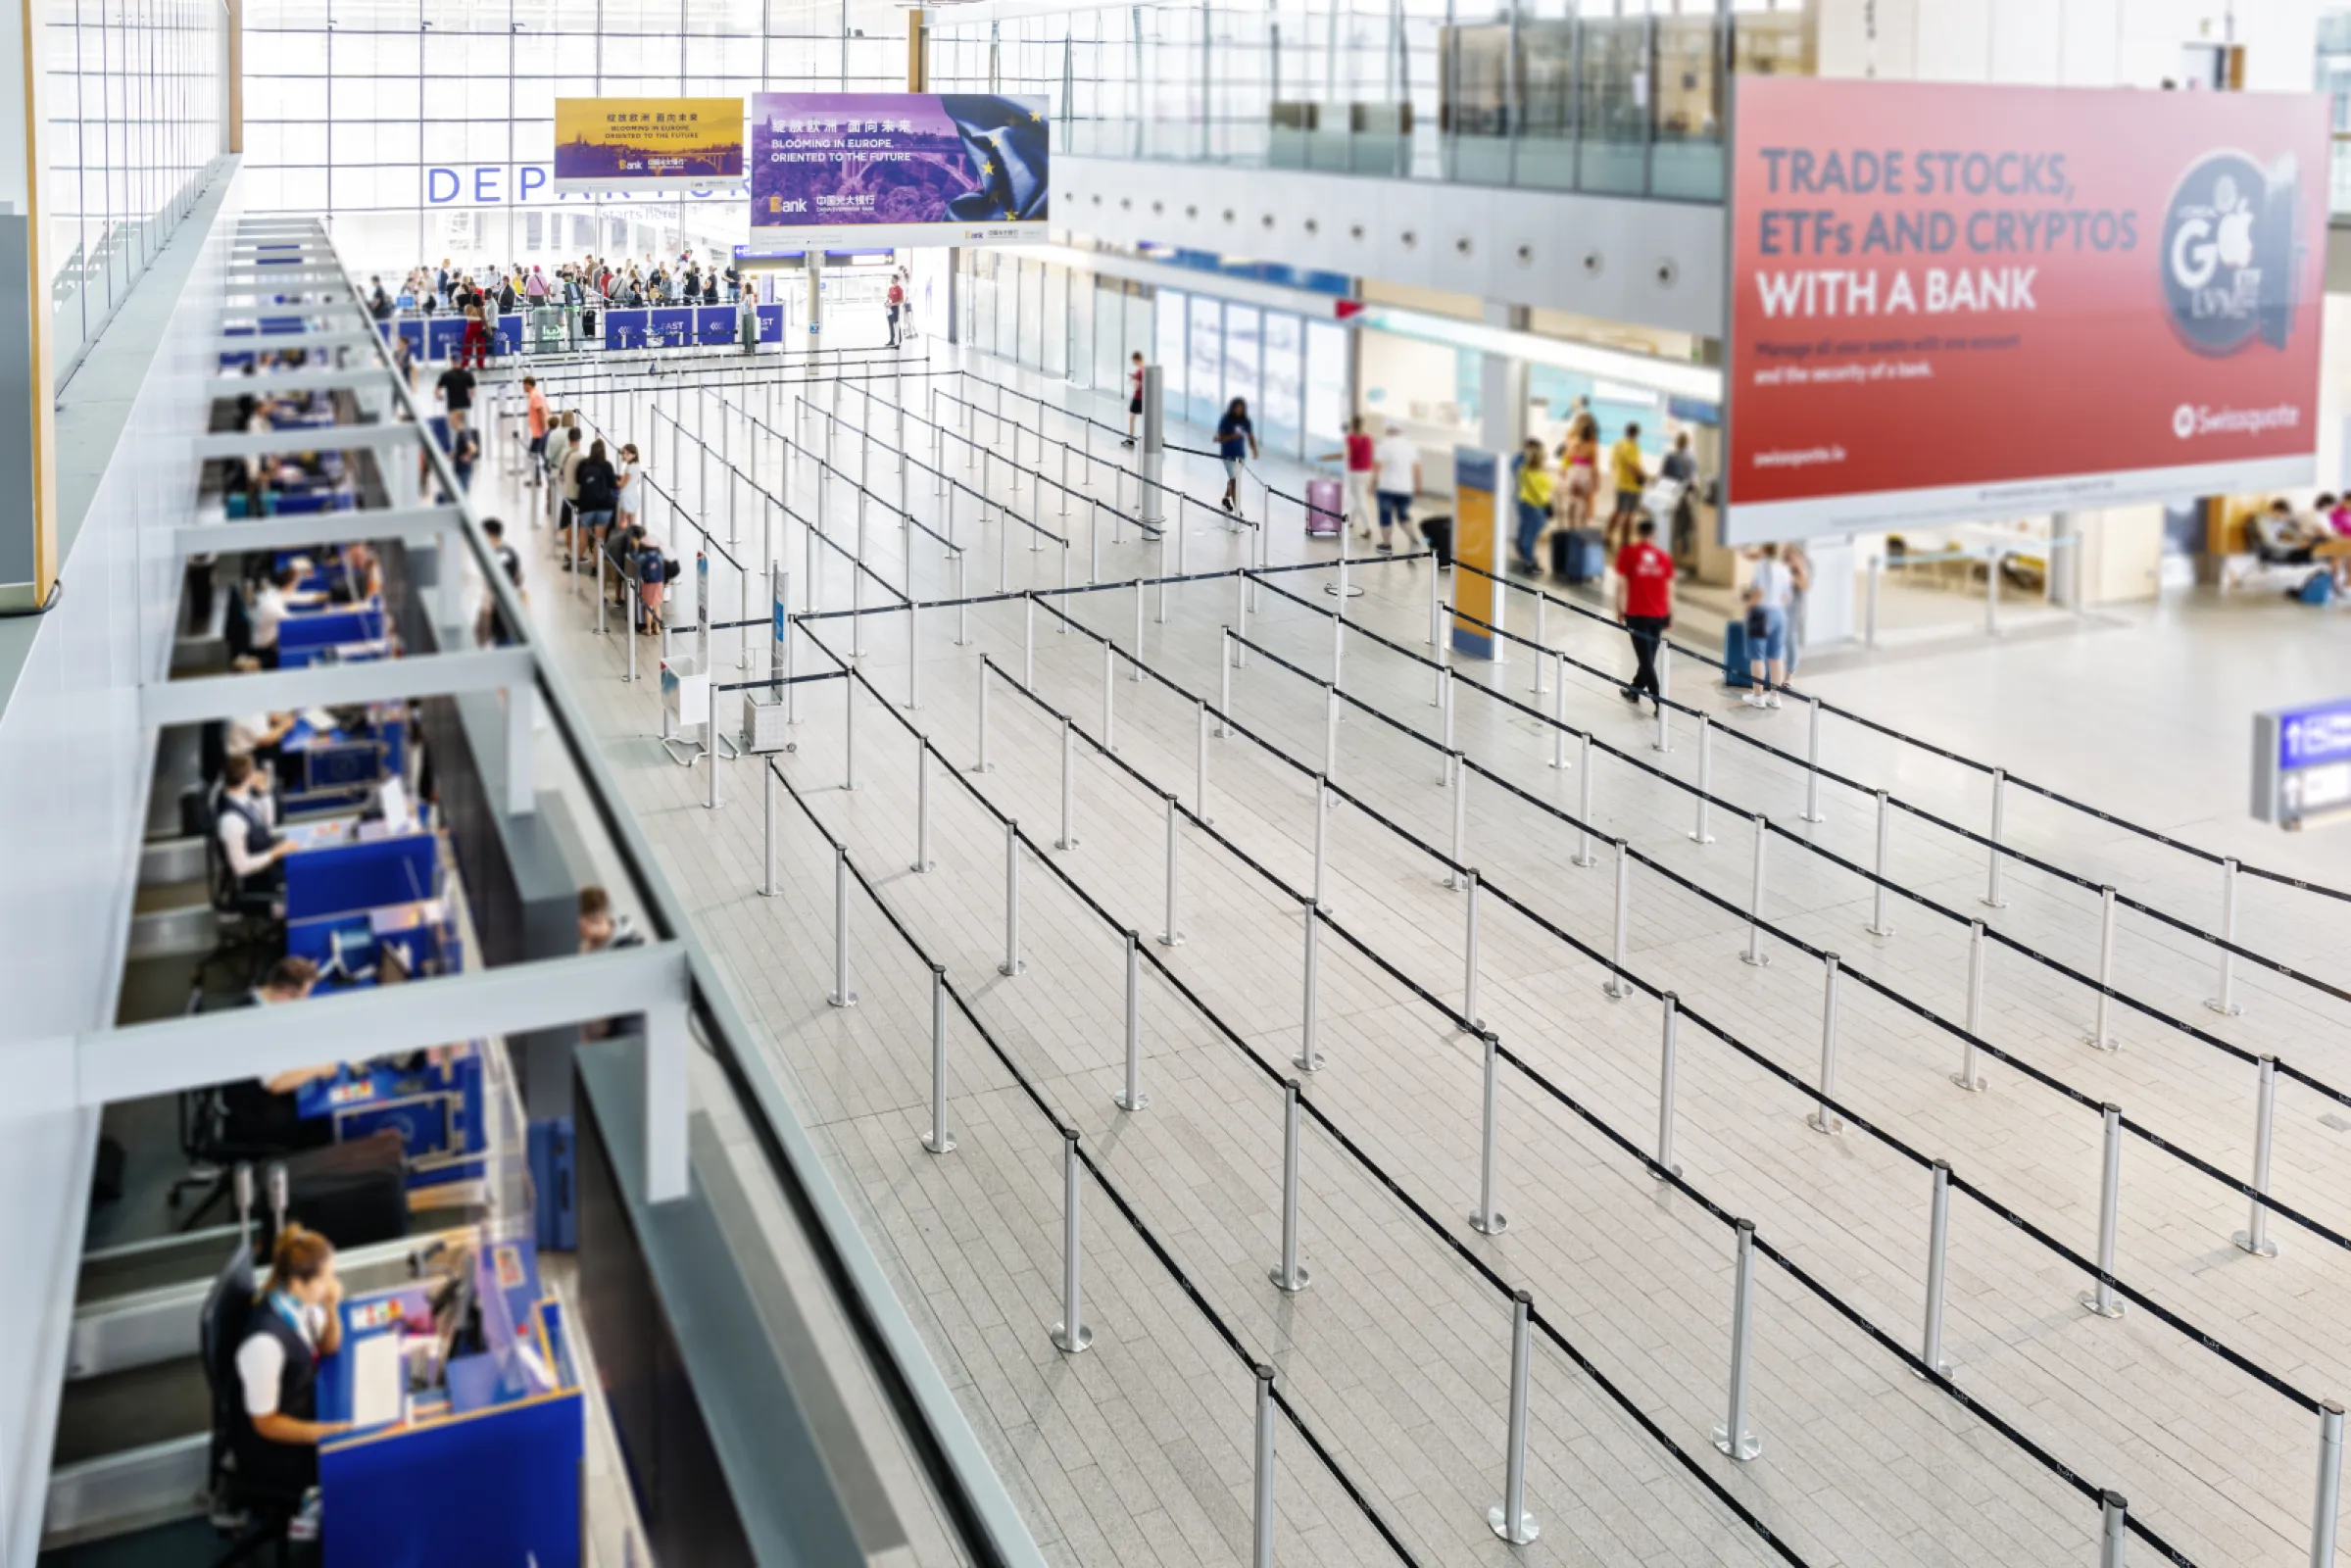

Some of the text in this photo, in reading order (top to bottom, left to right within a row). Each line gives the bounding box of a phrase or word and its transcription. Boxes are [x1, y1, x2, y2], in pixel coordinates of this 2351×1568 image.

[771, 139, 895, 149] BLOOMING IN EUROPE,
[770, 152, 911, 163] ORIENTED TO THE FUTURE
[1758, 147, 2077, 204] TRADE STOCKS,
[769, 195, 808, 213] Bank
[602, 209, 643, 221] starts
[1758, 209, 2139, 255] ETFs AND CRYPTOS
[1755, 266, 2038, 318] WITH A BANK
